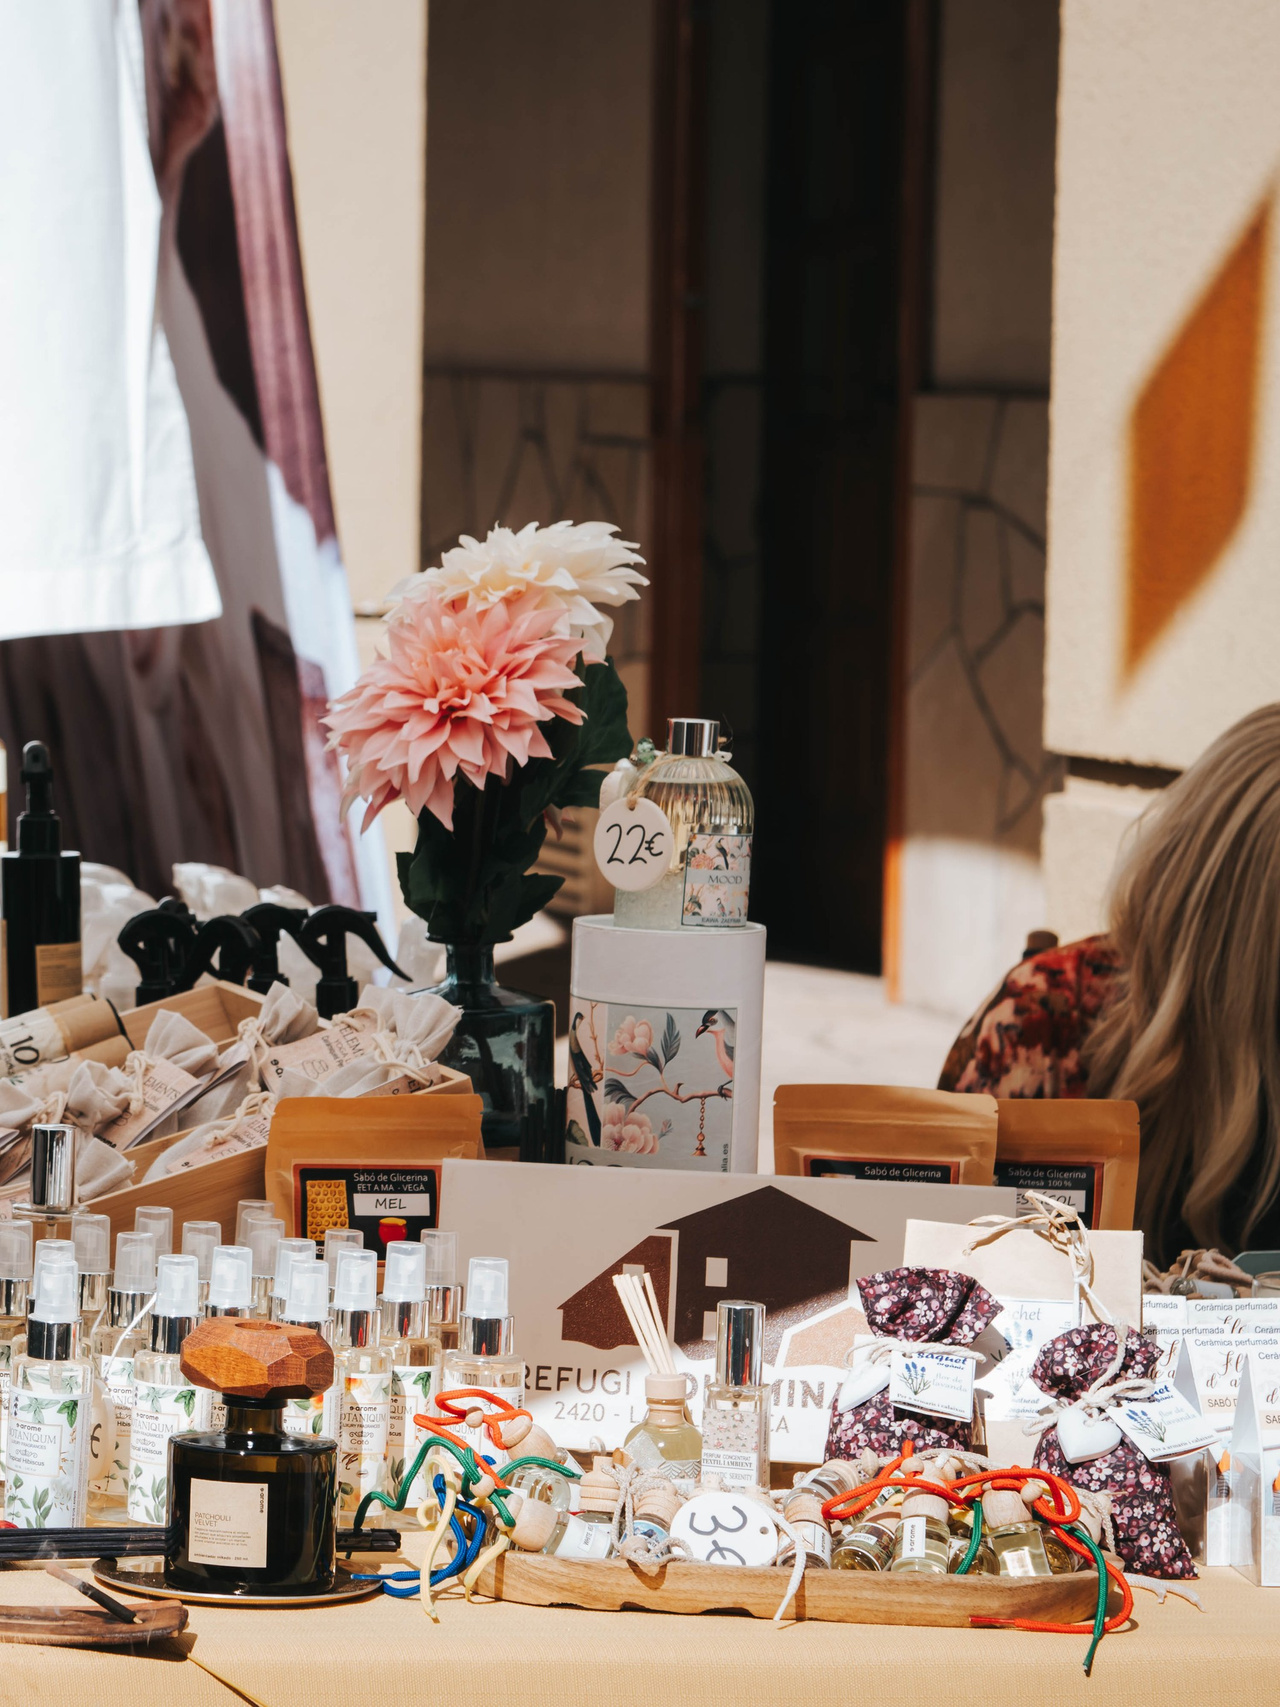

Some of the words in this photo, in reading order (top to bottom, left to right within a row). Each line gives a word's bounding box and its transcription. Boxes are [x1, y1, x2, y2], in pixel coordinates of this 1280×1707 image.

[606, 823, 665, 865] 22€
[708, 875, 743, 885] MOOD
[340, 1025, 366, 1057] ELEM
[10, 1035, 40, 1065] 10
[143, 1075, 181, 1101] EMENTS
[353, 1172, 375, 1182] Sabó
[377, 1173, 388, 1182] de
[390, 1173, 428, 1182] Glicerina
[864, 1166, 887, 1176] Sabó
[889, 1167, 901, 1176] de
[903, 1168, 942, 1178] Glicerina
[1008, 1167, 1031, 1177] Sabó
[1033, 1168, 1044, 1177] de
[1046, 1168, 1087, 1179] Glicerina
[402, 1183, 426, 1191] VEGÀ
[375, 1198, 407, 1210] MEL
[1142, 1301, 1178, 1309] erfumada
[1194, 1303, 1233, 1311] Ceràmica
[1235, 1303, 1278, 1312] perfumada
[1182, 1327, 1225, 1336] perfumada
[1254, 1326, 1280, 1334] Ceràm
[1237, 1338, 1279, 1347] perfumada
[917, 1352, 968, 1365] saquet
[1207, 1398, 1232, 1408] SABÓ
[554, 1401, 605, 1422] 2420
[1265, 1415, 1280, 1424] SAB
[22, 1457, 46, 1466] Hibiscus
[729, 1472, 753, 1481] SERENITY
[194, 1511, 232, 1522] PATCHOULI
[194, 1518, 217, 1527] VELVET
